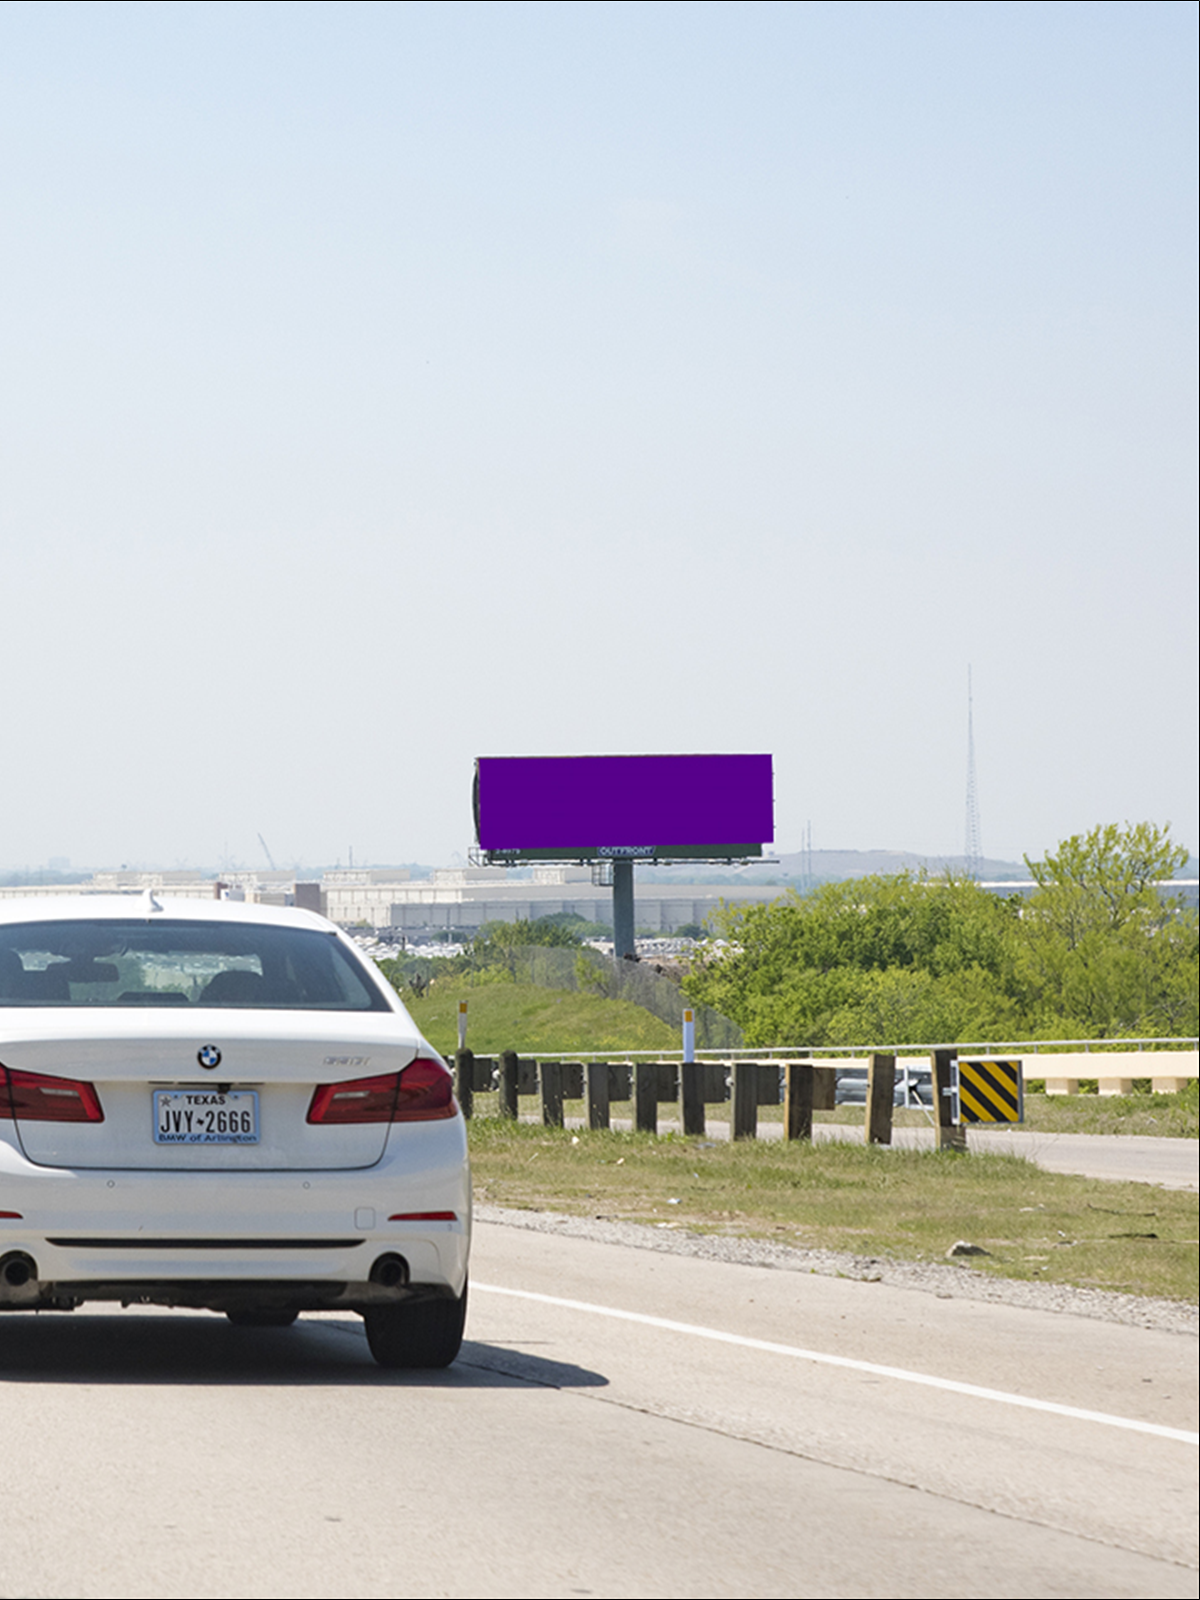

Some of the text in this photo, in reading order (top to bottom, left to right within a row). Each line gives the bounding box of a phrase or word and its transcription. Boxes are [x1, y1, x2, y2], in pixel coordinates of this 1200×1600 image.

[600, 846, 654, 855] OUTFRONT
[186, 1095, 226, 1105] TEXAS
[191, 1134, 201, 1142] of
[205, 1134, 257, 1143] Arlington
